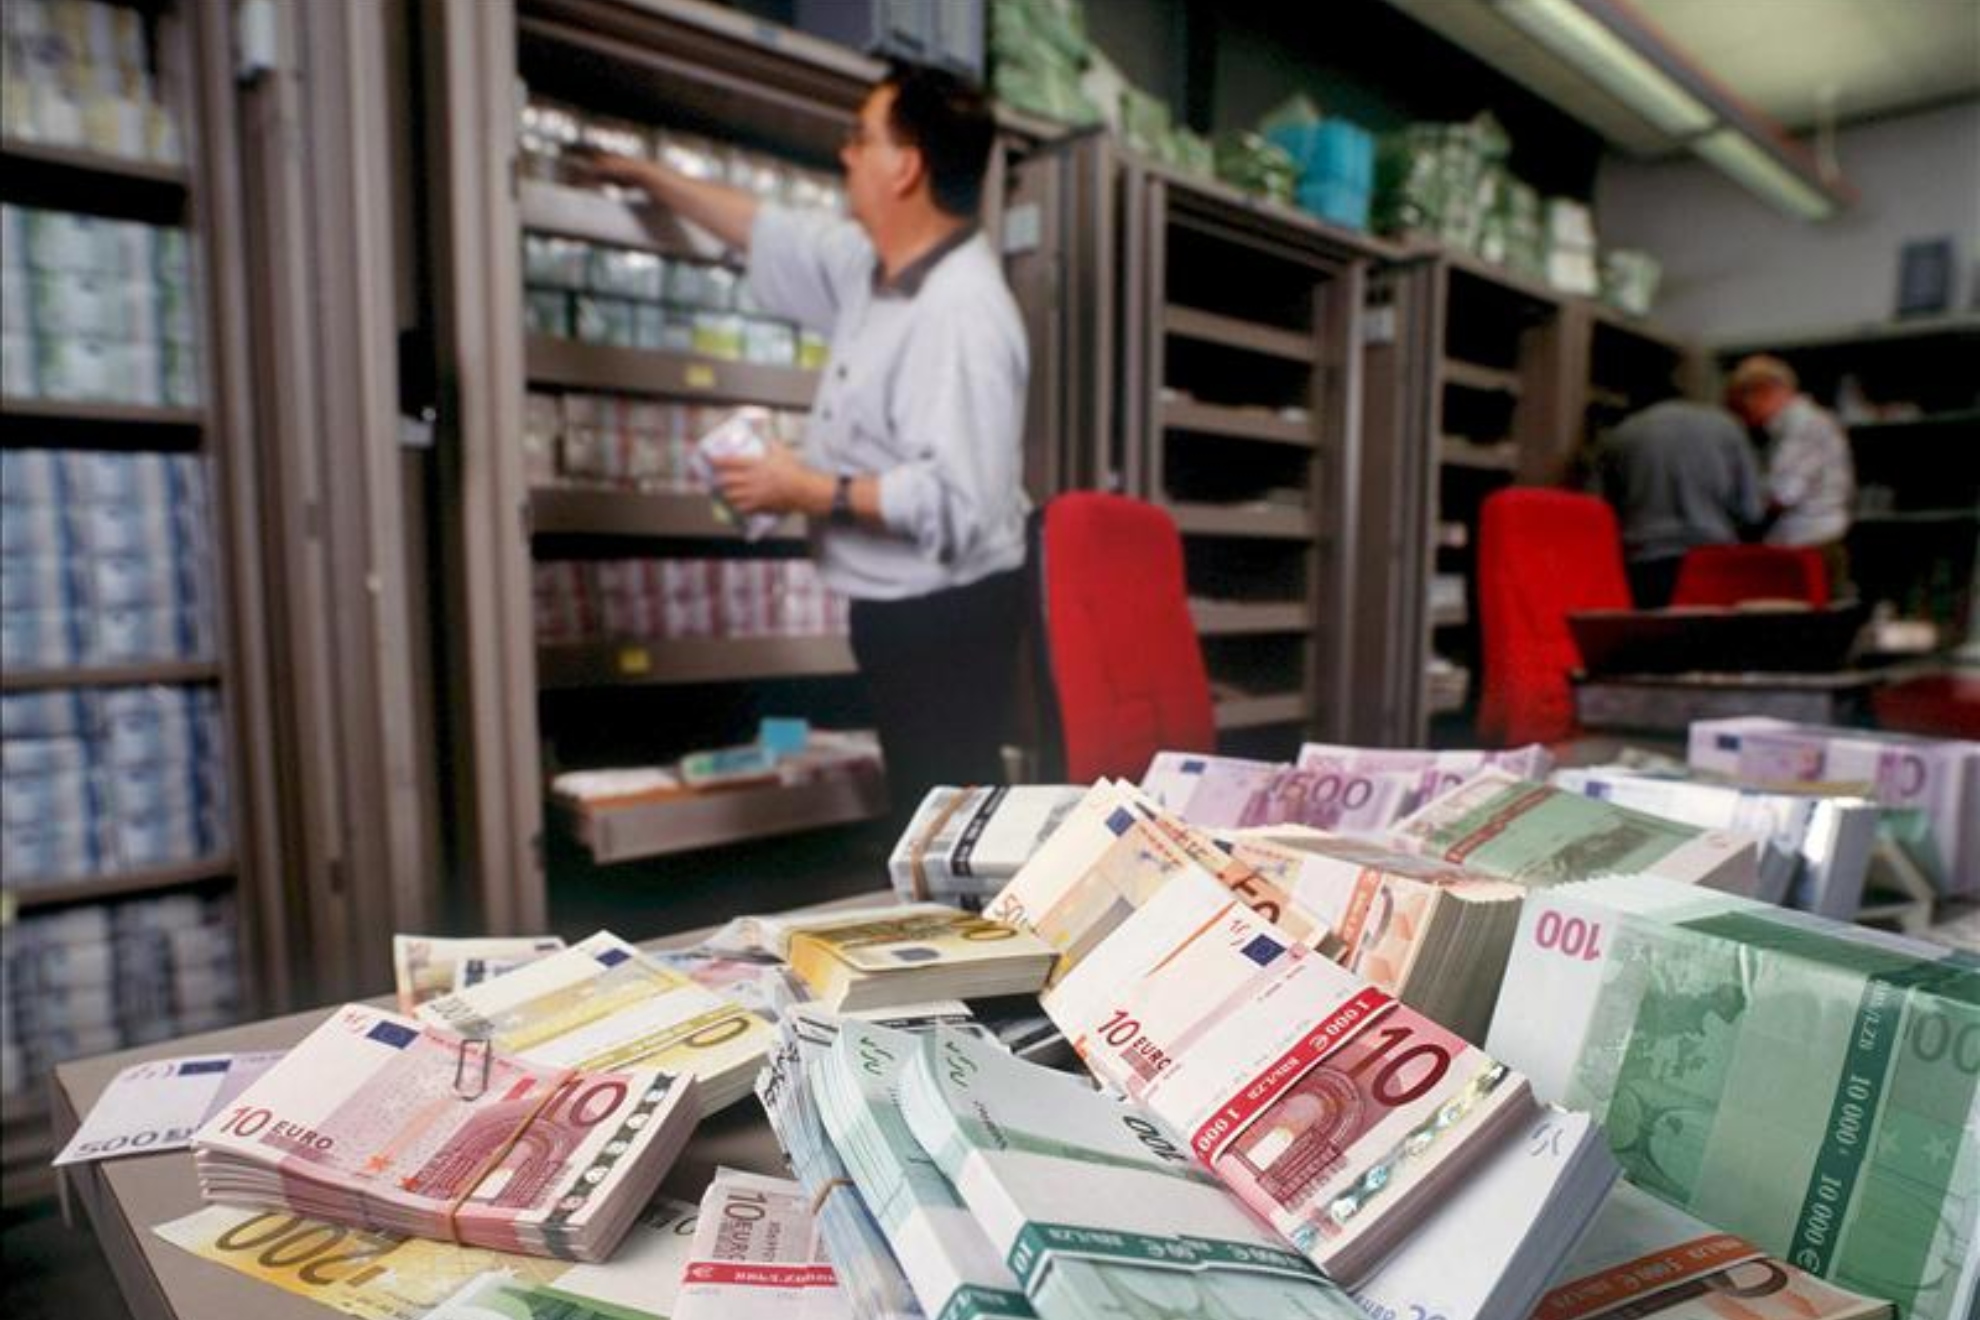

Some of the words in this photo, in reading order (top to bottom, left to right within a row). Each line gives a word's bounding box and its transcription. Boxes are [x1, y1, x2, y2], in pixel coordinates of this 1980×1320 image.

[1535, 910, 1600, 961] 100
[1097, 1010, 1141, 1047] 10
[1904, 1012, 1980, 1074] 00
[1347, 1026, 1451, 1107] 10
[1848, 1075, 1872, 1100] 10
[220, 1105, 272, 1137] 10
[272, 1120, 334, 1150] EURO
[1837, 1102, 1865, 1144] 000
[723, 1193, 769, 1222] 10
[1820, 1175, 1842, 1201] 10
[1805, 1203, 1832, 1246] 000
